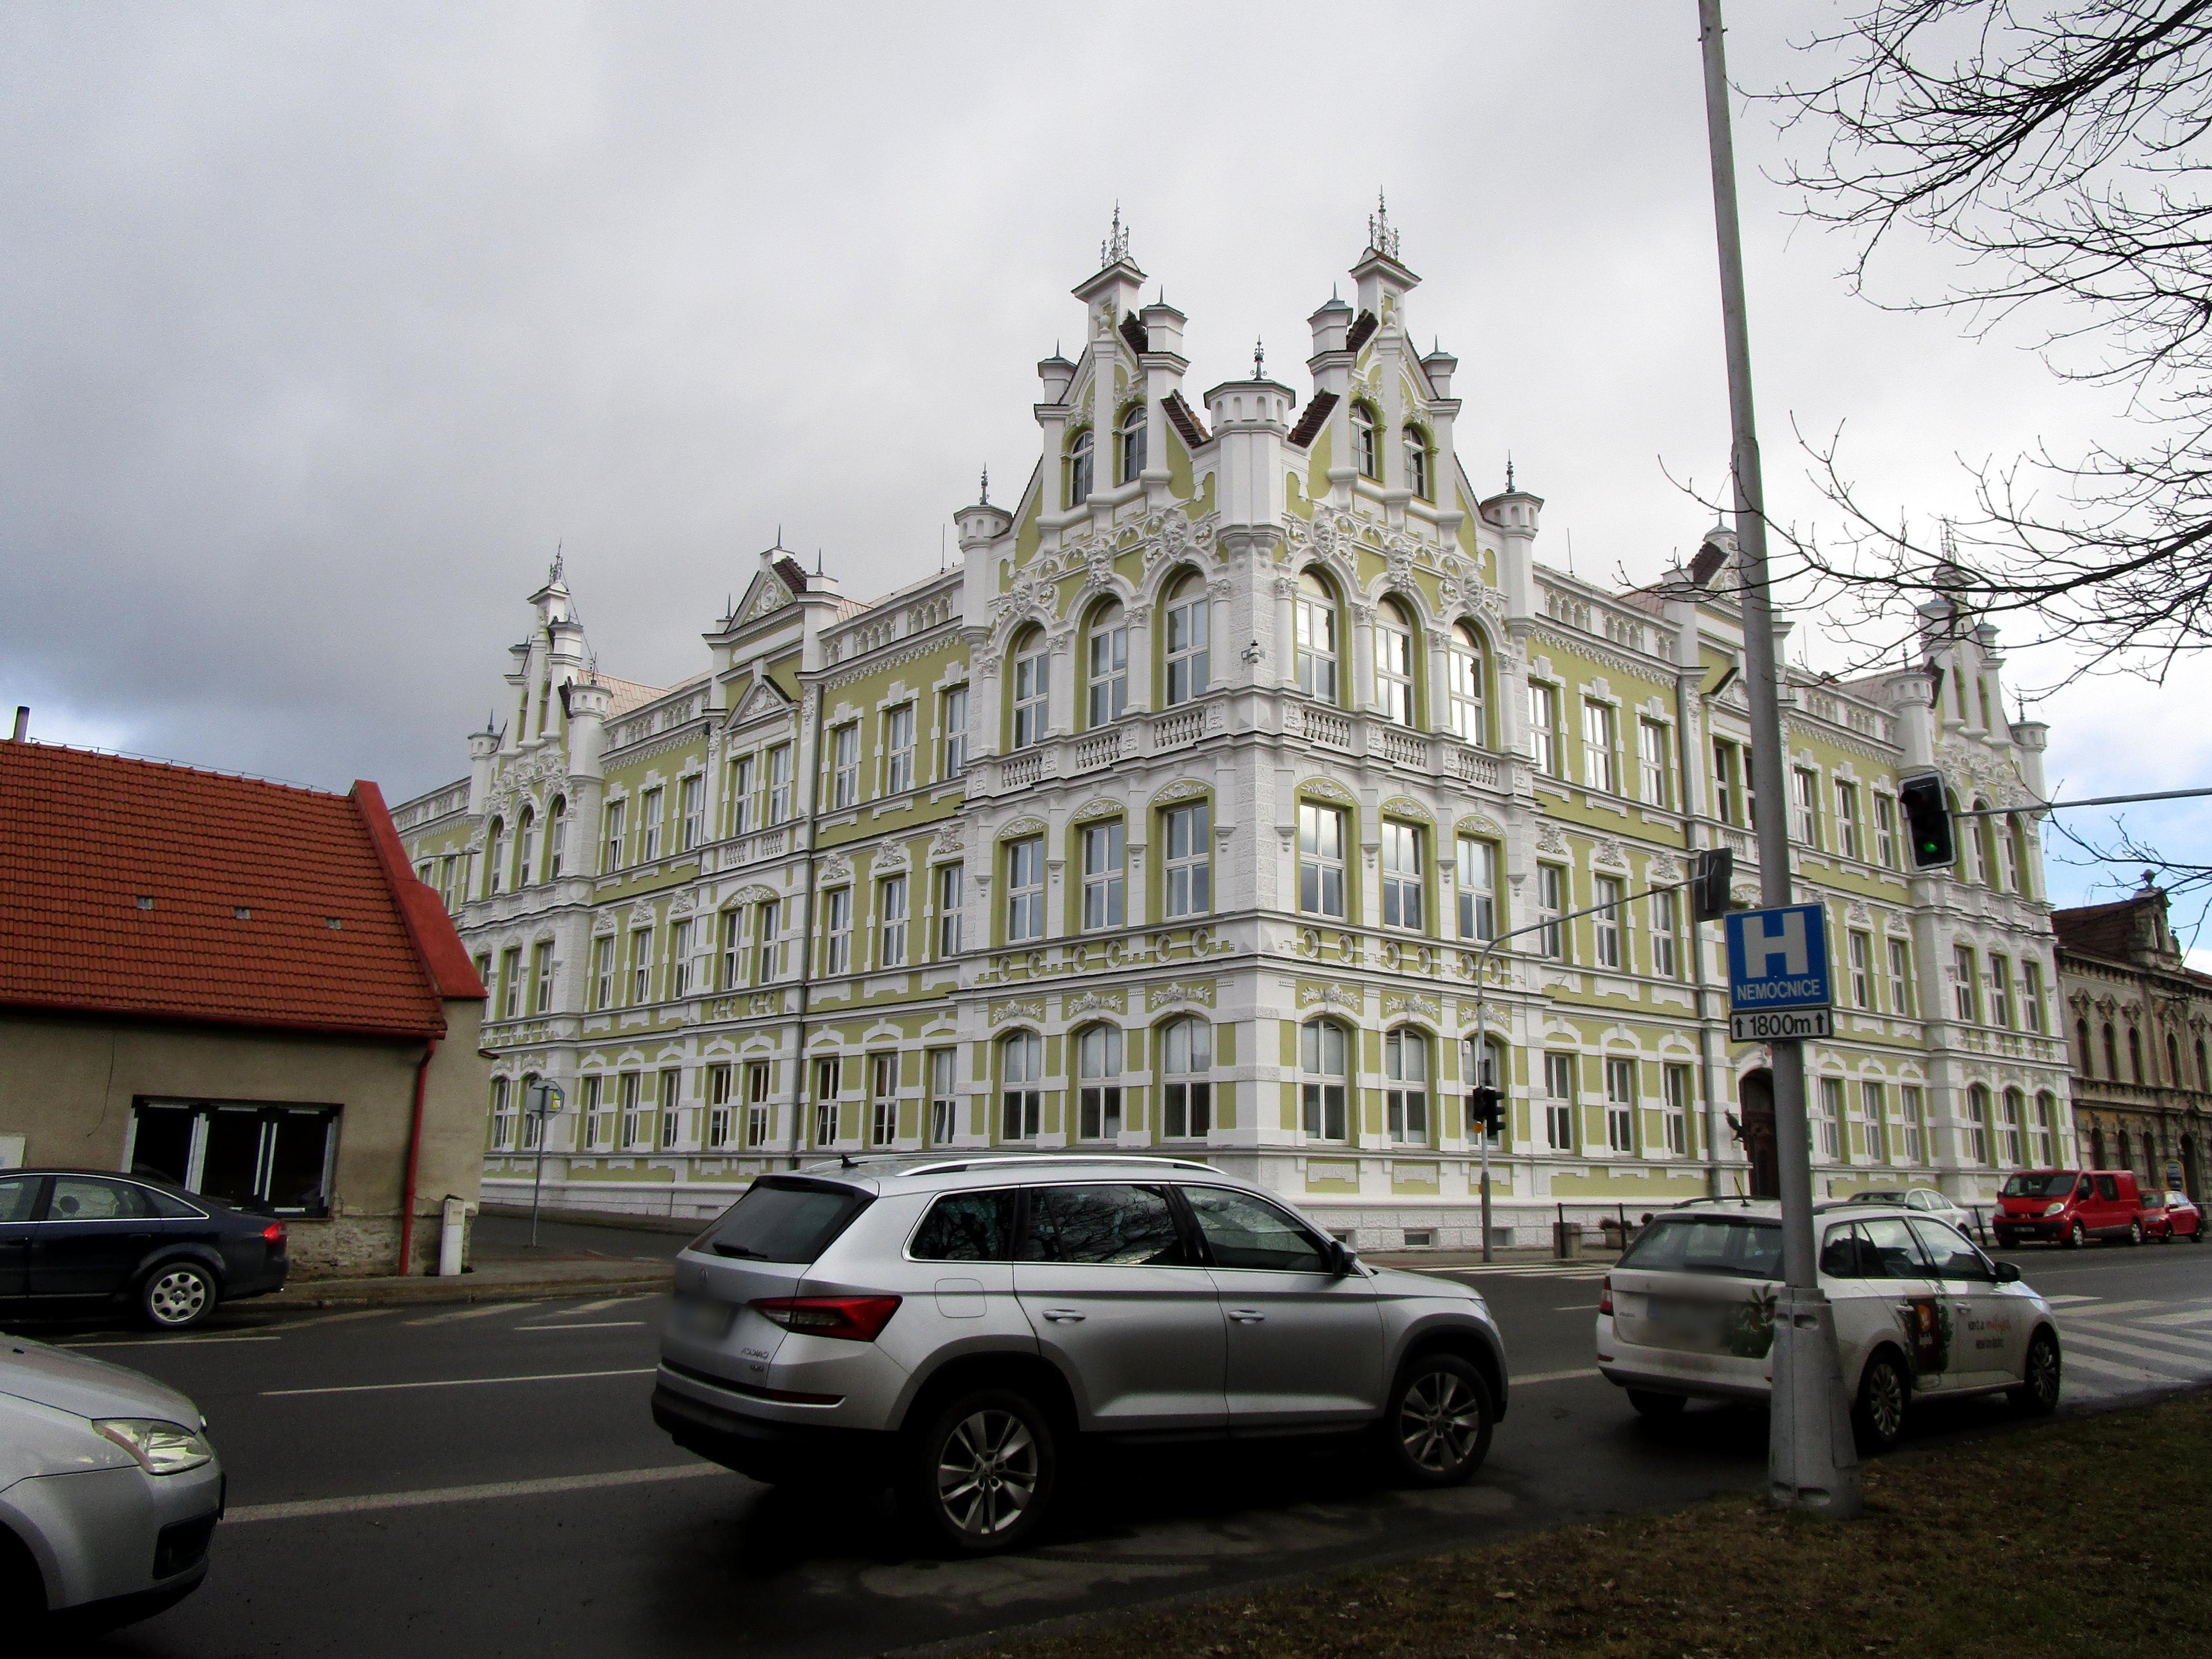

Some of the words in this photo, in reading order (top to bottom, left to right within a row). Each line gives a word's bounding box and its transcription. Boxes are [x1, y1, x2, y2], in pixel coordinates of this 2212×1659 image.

[1743, 911, 1808, 978] H
[1736, 979, 1821, 1000] NEMOCNICE
[1750, 1014, 1811, 1036] 1800m
